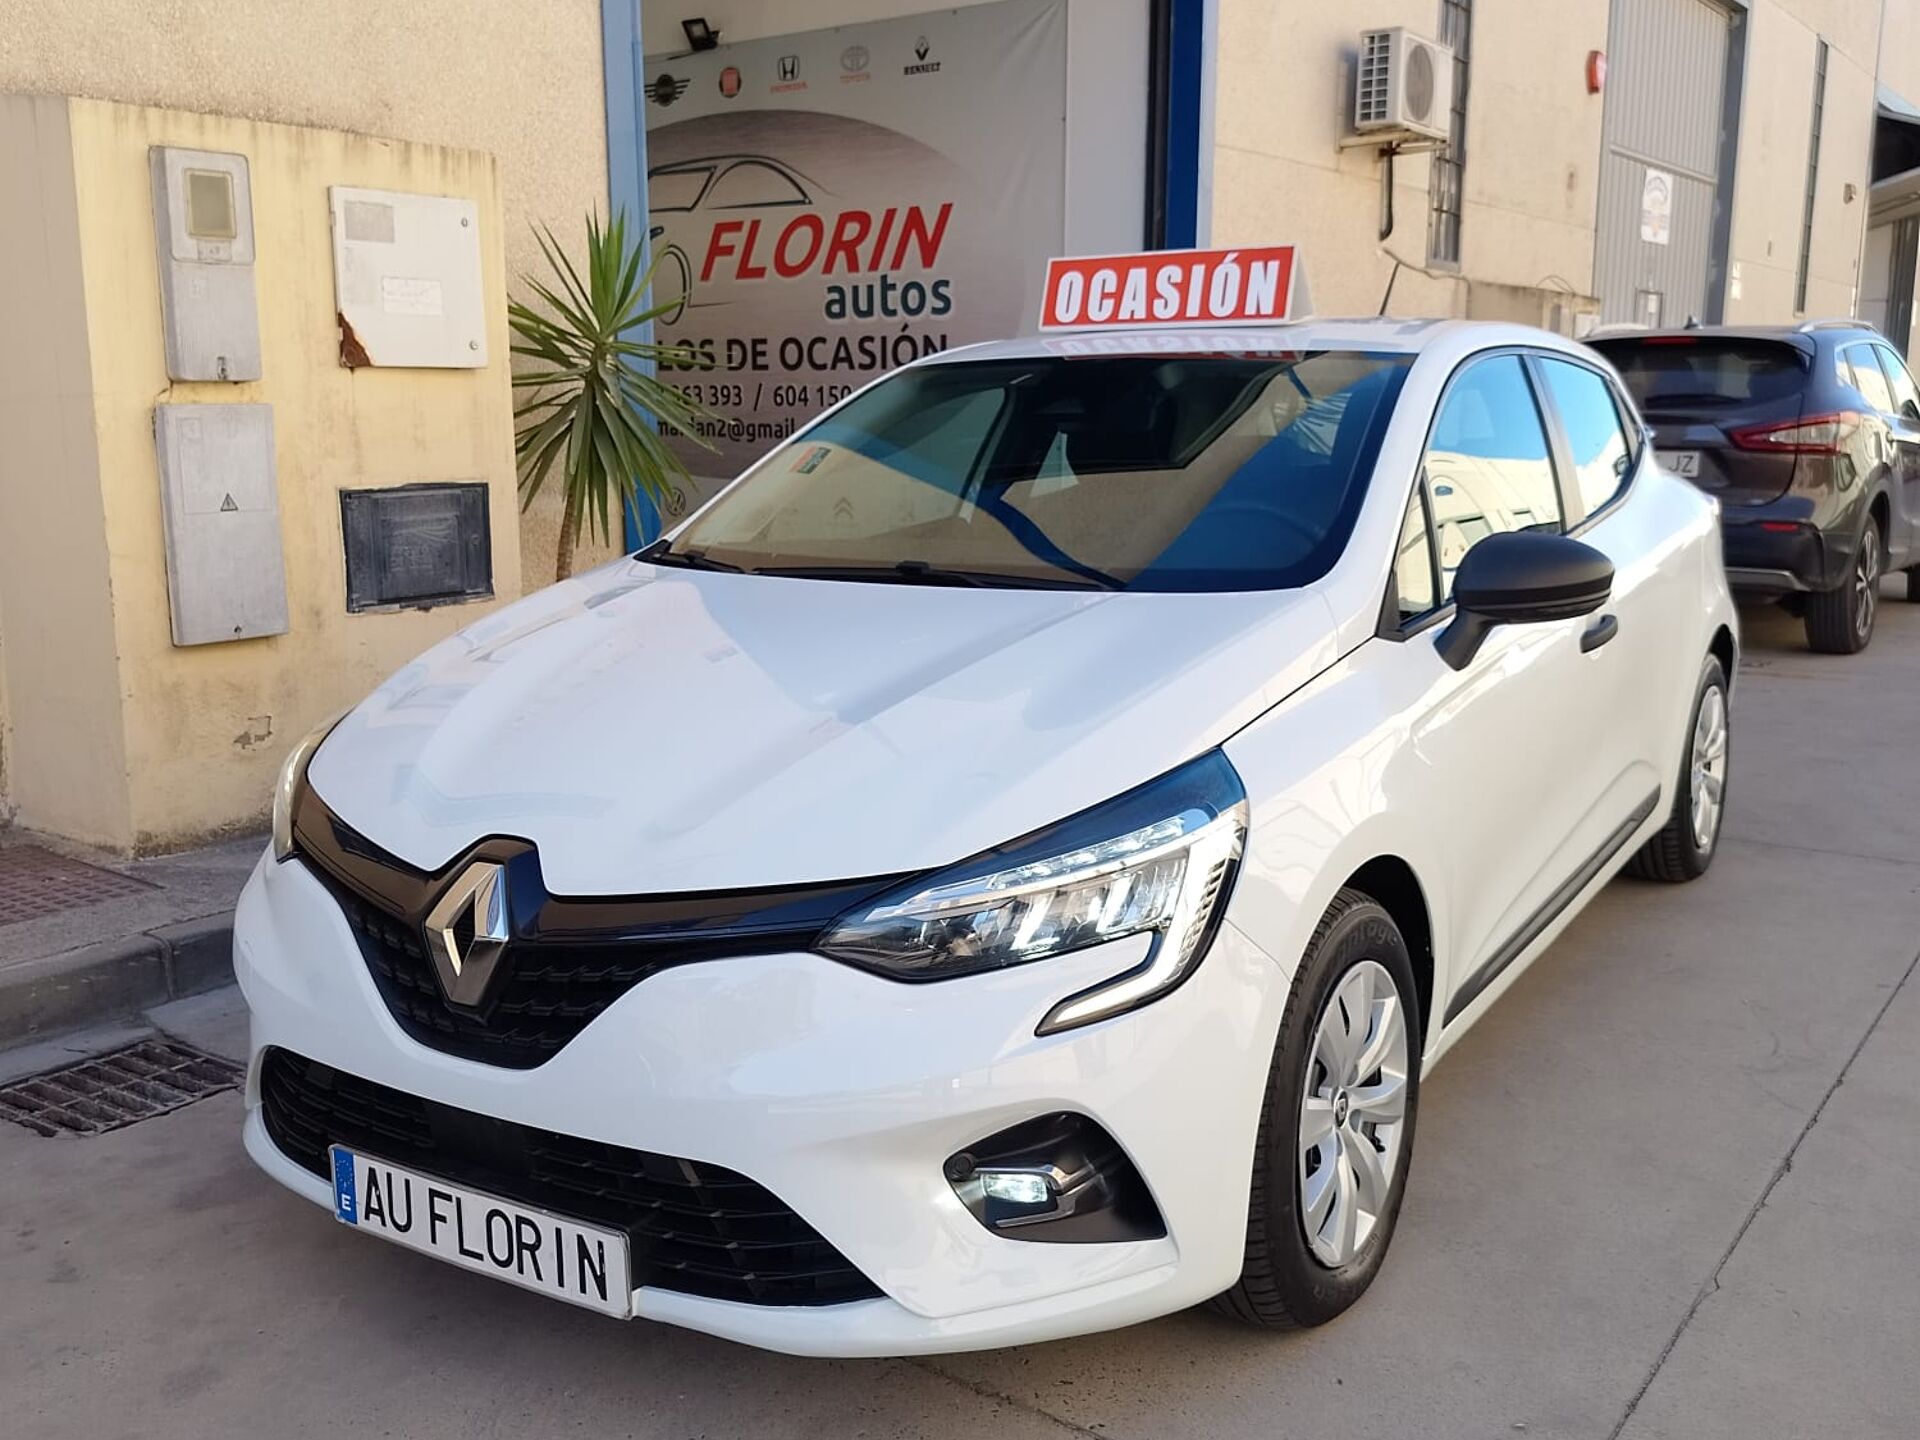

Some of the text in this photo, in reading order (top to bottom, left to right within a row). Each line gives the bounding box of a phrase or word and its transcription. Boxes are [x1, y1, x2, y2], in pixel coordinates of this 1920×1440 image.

[701, 203, 953, 281] FLORIN
[824, 274, 952, 319] autos
[1054, 252, 1280, 323] OCASIÓN
[726, 338, 769, 371] DE
[779, 323, 947, 371] OCASIÓN
[709, 384, 742, 406] 393
[774, 385, 809, 407] 604
[341, 1194, 351, 1211] E
[364, 1166, 608, 1302] AU FLORIN
